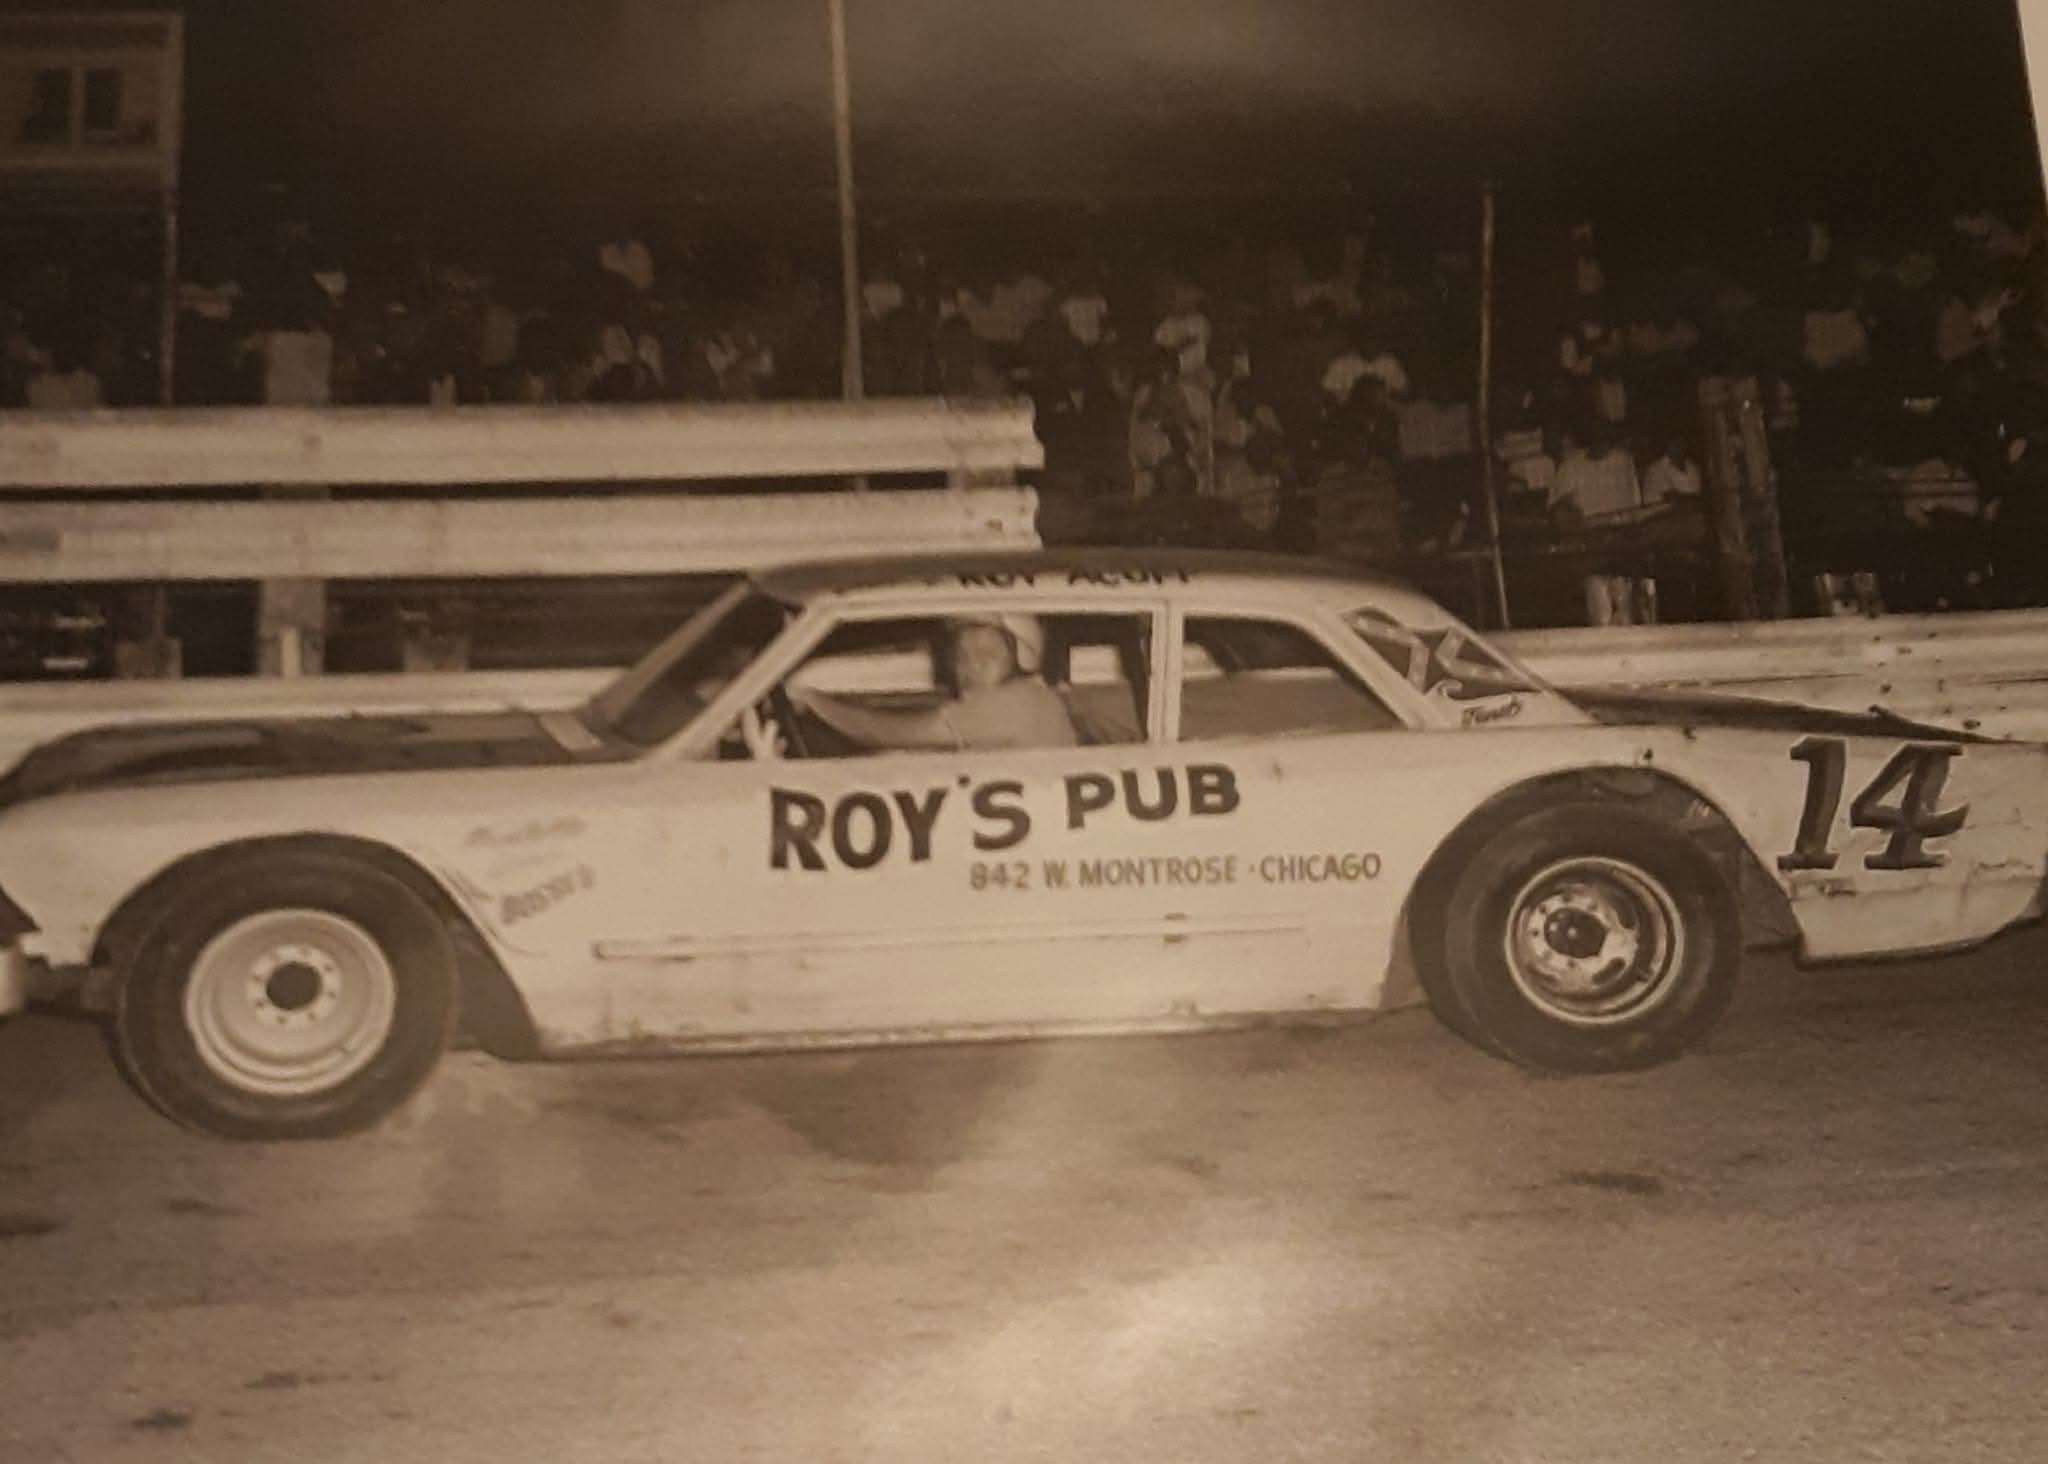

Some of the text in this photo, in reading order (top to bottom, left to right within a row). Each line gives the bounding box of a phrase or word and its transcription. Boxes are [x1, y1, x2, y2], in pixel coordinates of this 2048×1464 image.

[769, 762, 1241, 871] ROY'S PUB
[1776, 736, 1971, 870] 14
[970, 860, 1031, 891] 842
[1078, 854, 1238, 888] MONTROSE
[1259, 852, 1382, 884] CHICAGO
